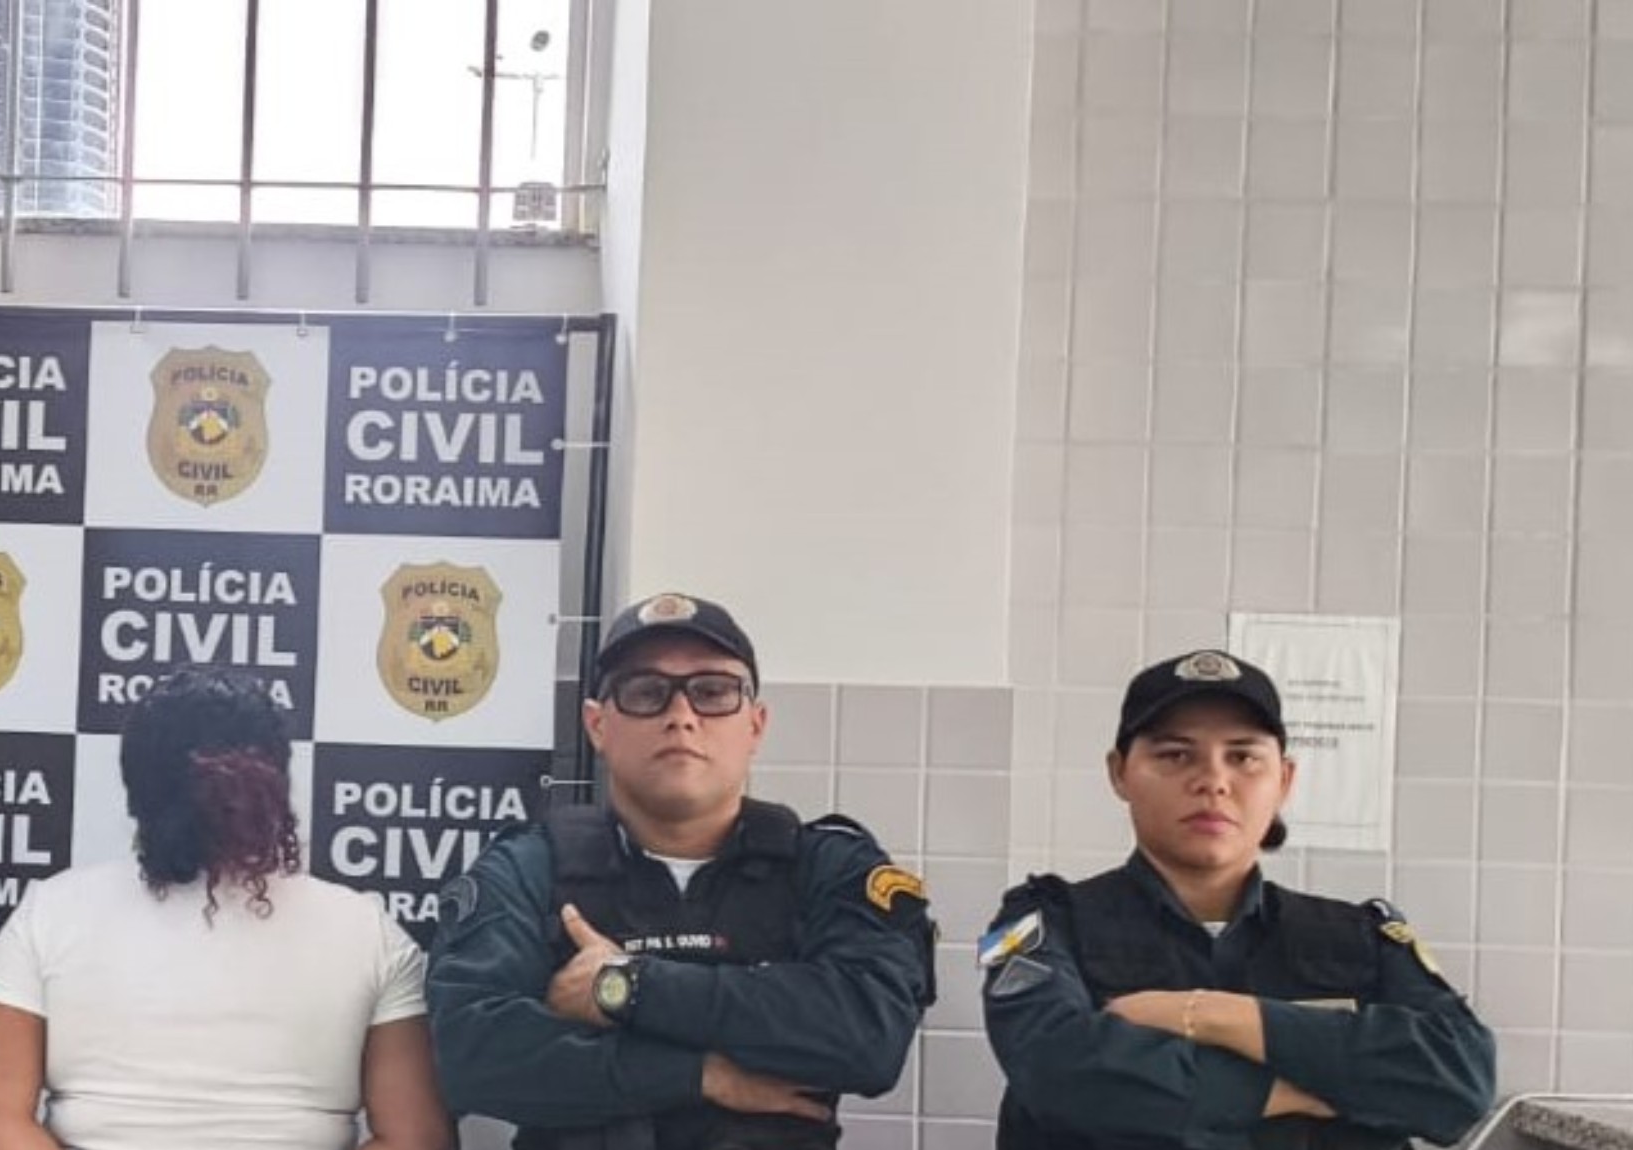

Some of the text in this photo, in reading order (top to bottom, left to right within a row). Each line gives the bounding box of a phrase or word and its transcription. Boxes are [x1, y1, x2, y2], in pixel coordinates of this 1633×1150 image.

[171, 363, 249, 386] POLÍCIA
[349, 360, 543, 404] POLÍCIA
[346, 409, 544, 465] CIVIL
[178, 460, 234, 480] CIVIL
[194, 484, 218, 497] RR
[344, 474, 541, 509] RORAIMA
[103, 562, 297, 606] POLÍCIA
[402, 579, 480, 602] POLÍCIA
[101, 612, 297, 667] CIVIL
[408, 677, 465, 697] CIVIL
[425, 699, 449, 713] RR
[333, 777, 527, 821] POLÍCIA
[331, 825, 498, 879] CIVI
